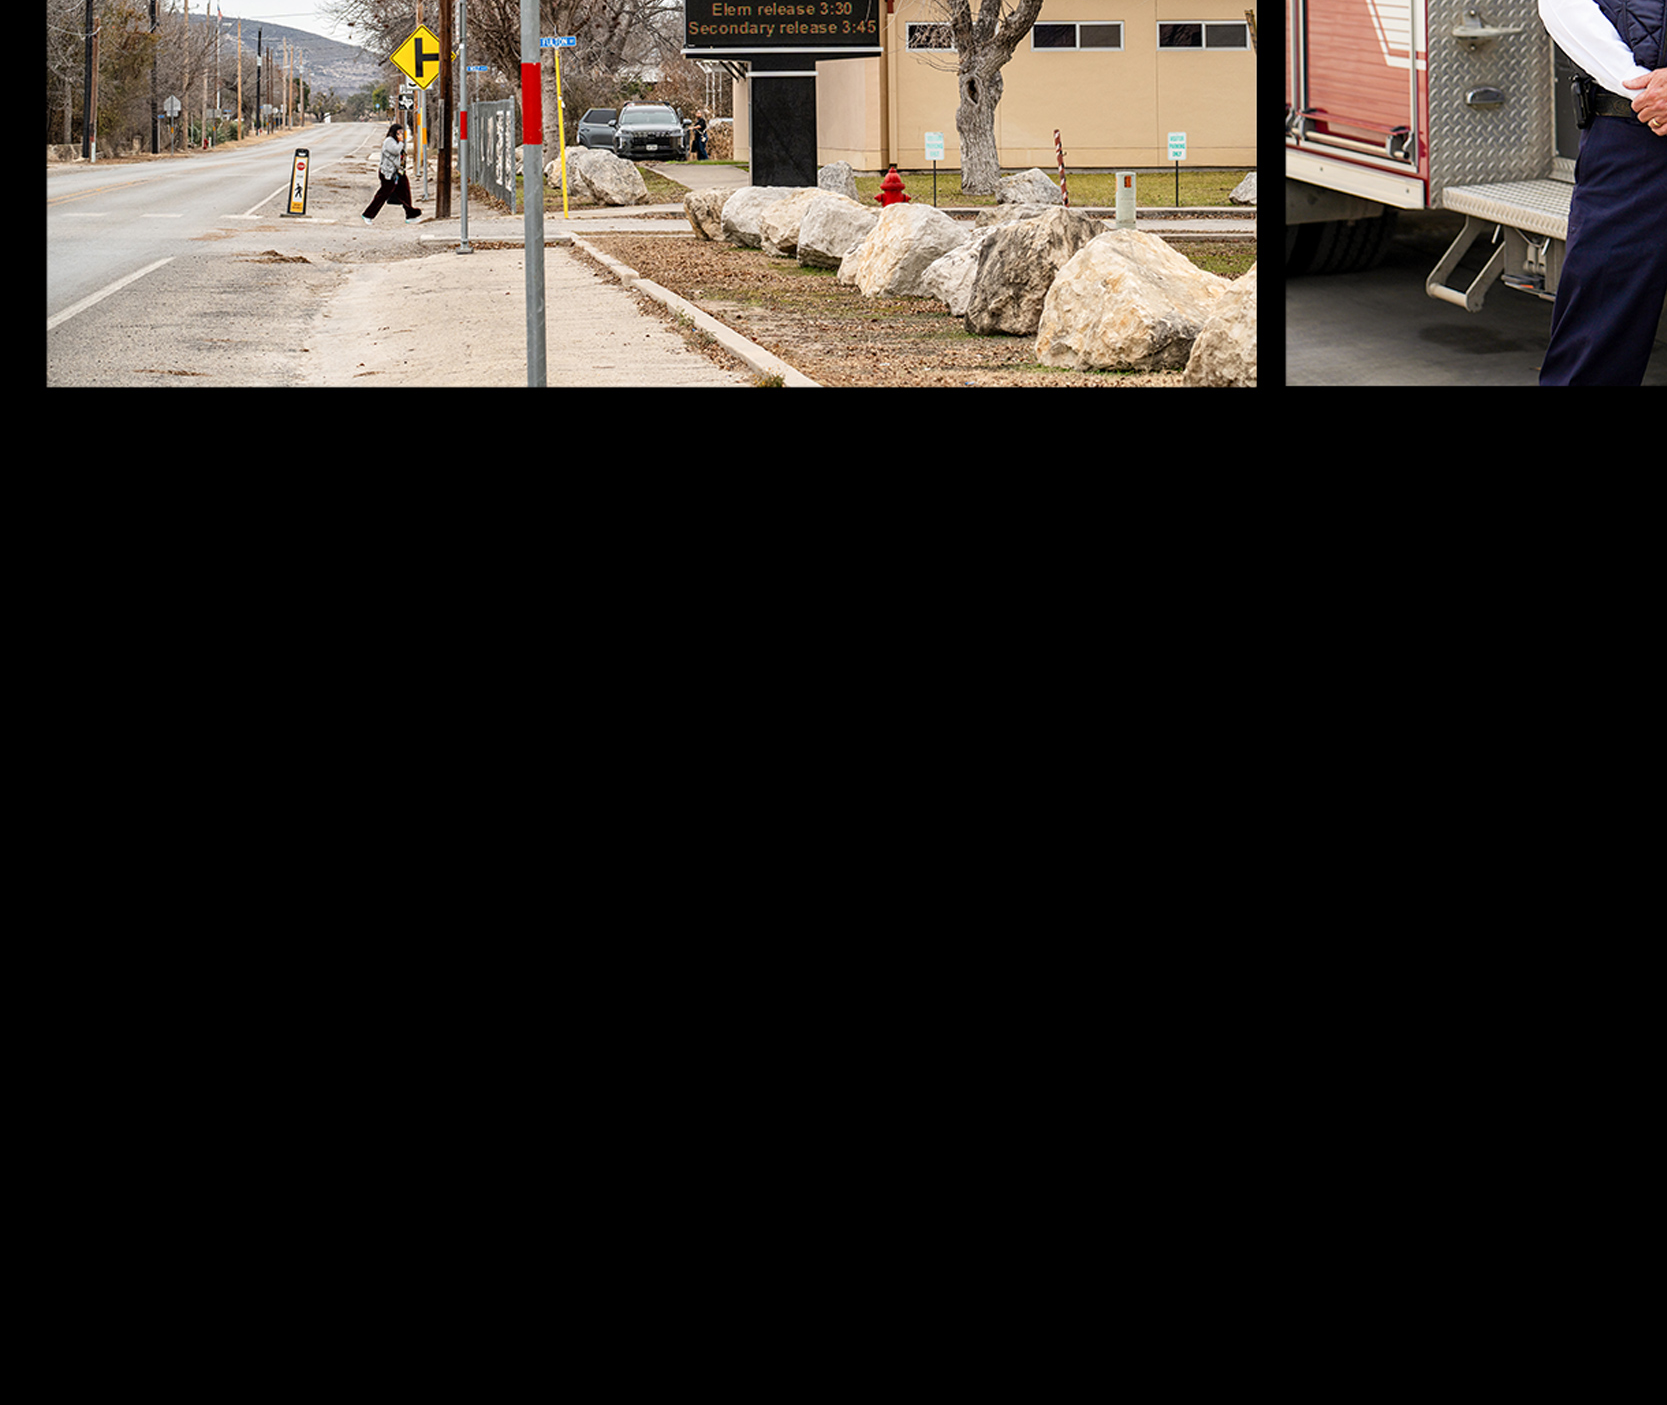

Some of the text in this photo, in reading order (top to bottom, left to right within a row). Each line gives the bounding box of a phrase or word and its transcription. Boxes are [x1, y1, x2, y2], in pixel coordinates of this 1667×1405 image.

[712, 2, 853, 17] Elem release 3:30
[688, 20, 877, 37] Secondary release 3:45
